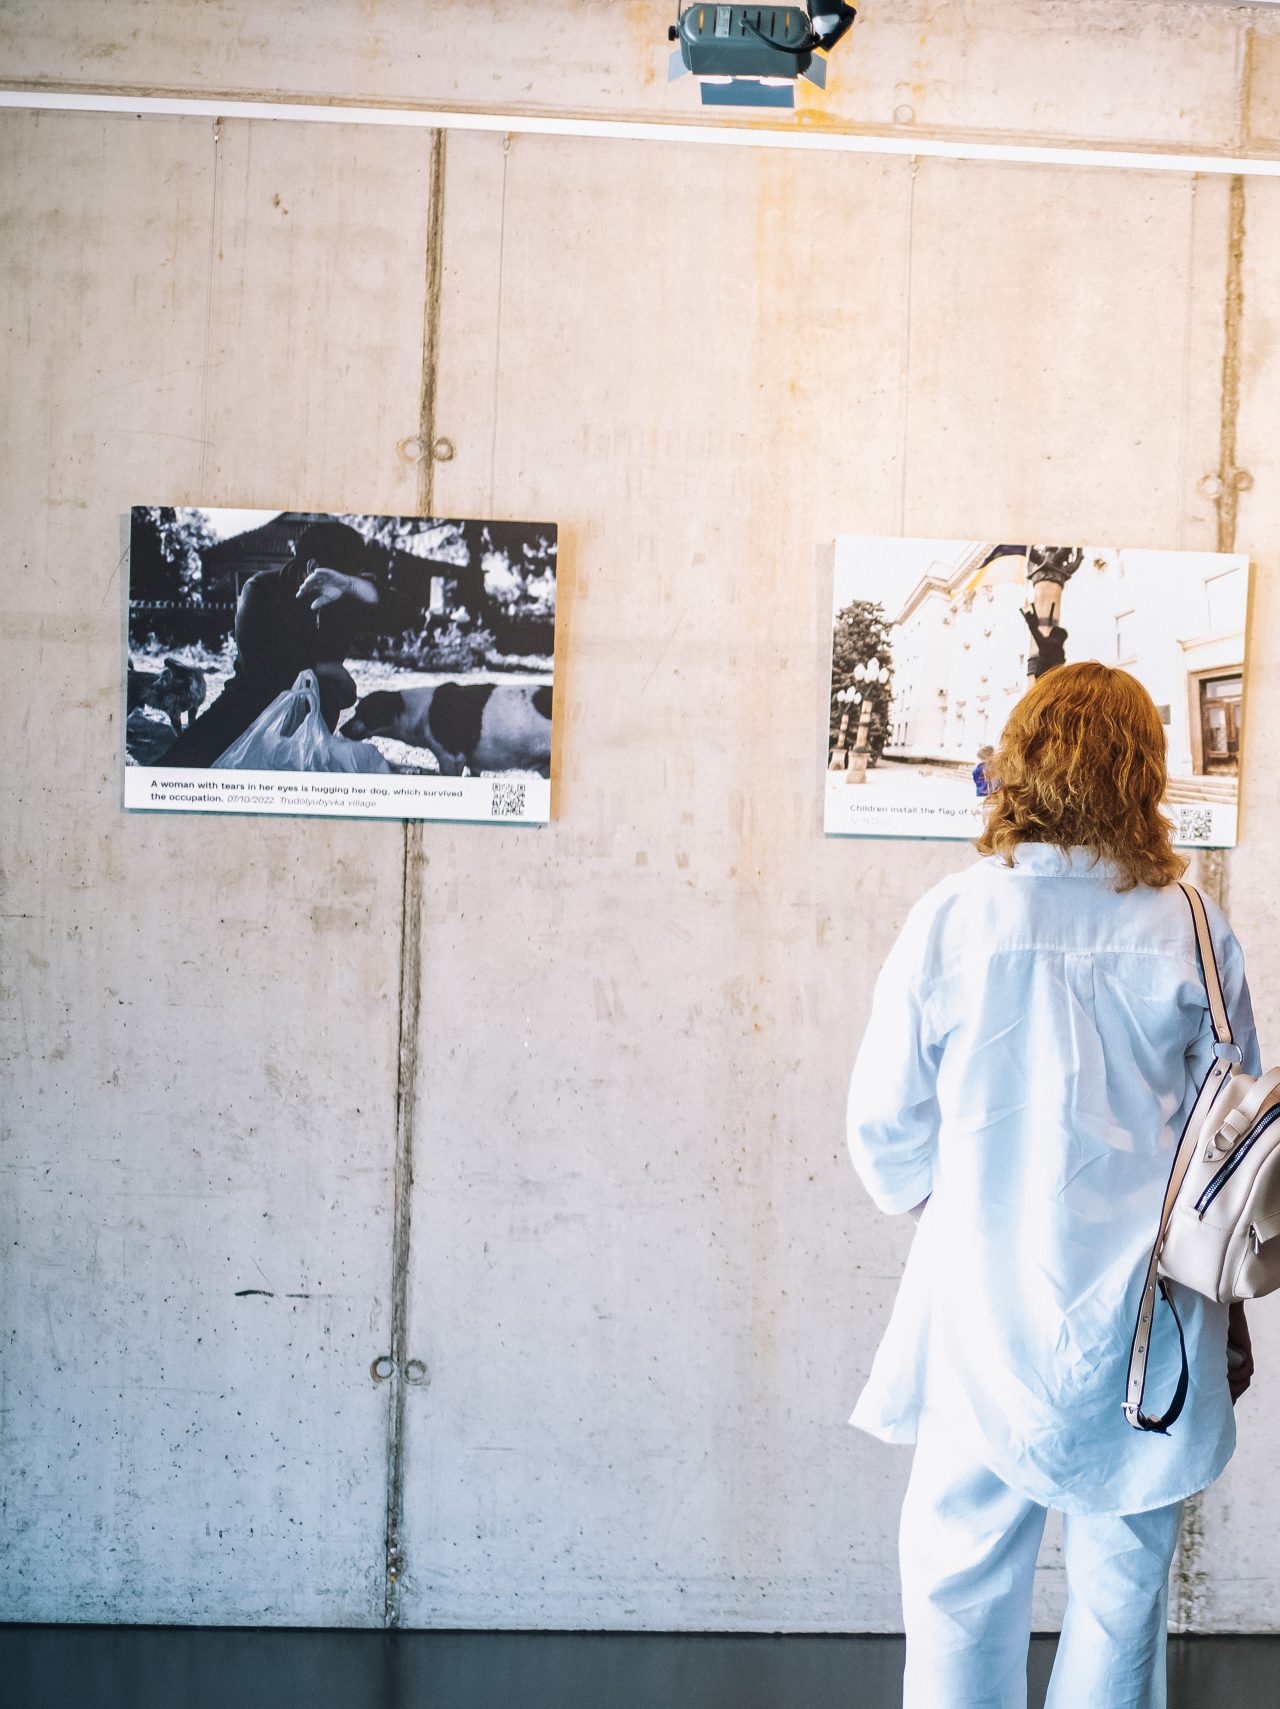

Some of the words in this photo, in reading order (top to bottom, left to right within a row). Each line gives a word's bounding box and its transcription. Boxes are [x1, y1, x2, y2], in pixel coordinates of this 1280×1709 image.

[151, 780, 158, 788] A
[160, 781, 195, 789] woman
[197, 782, 218, 790] with
[247, 783, 257, 791] in
[277, 785, 298, 793] eyes
[311, 786, 349, 794] hugging
[370, 787, 390, 796] dog,
[393, 788, 421, 796] which
[423, 789, 463, 797] survived
[169, 794, 224, 803] occupation.
[348, 799, 377, 808] village
[850, 804, 888, 813] Children
[890, 806, 918, 814] install
[938, 807, 956, 817] flag
